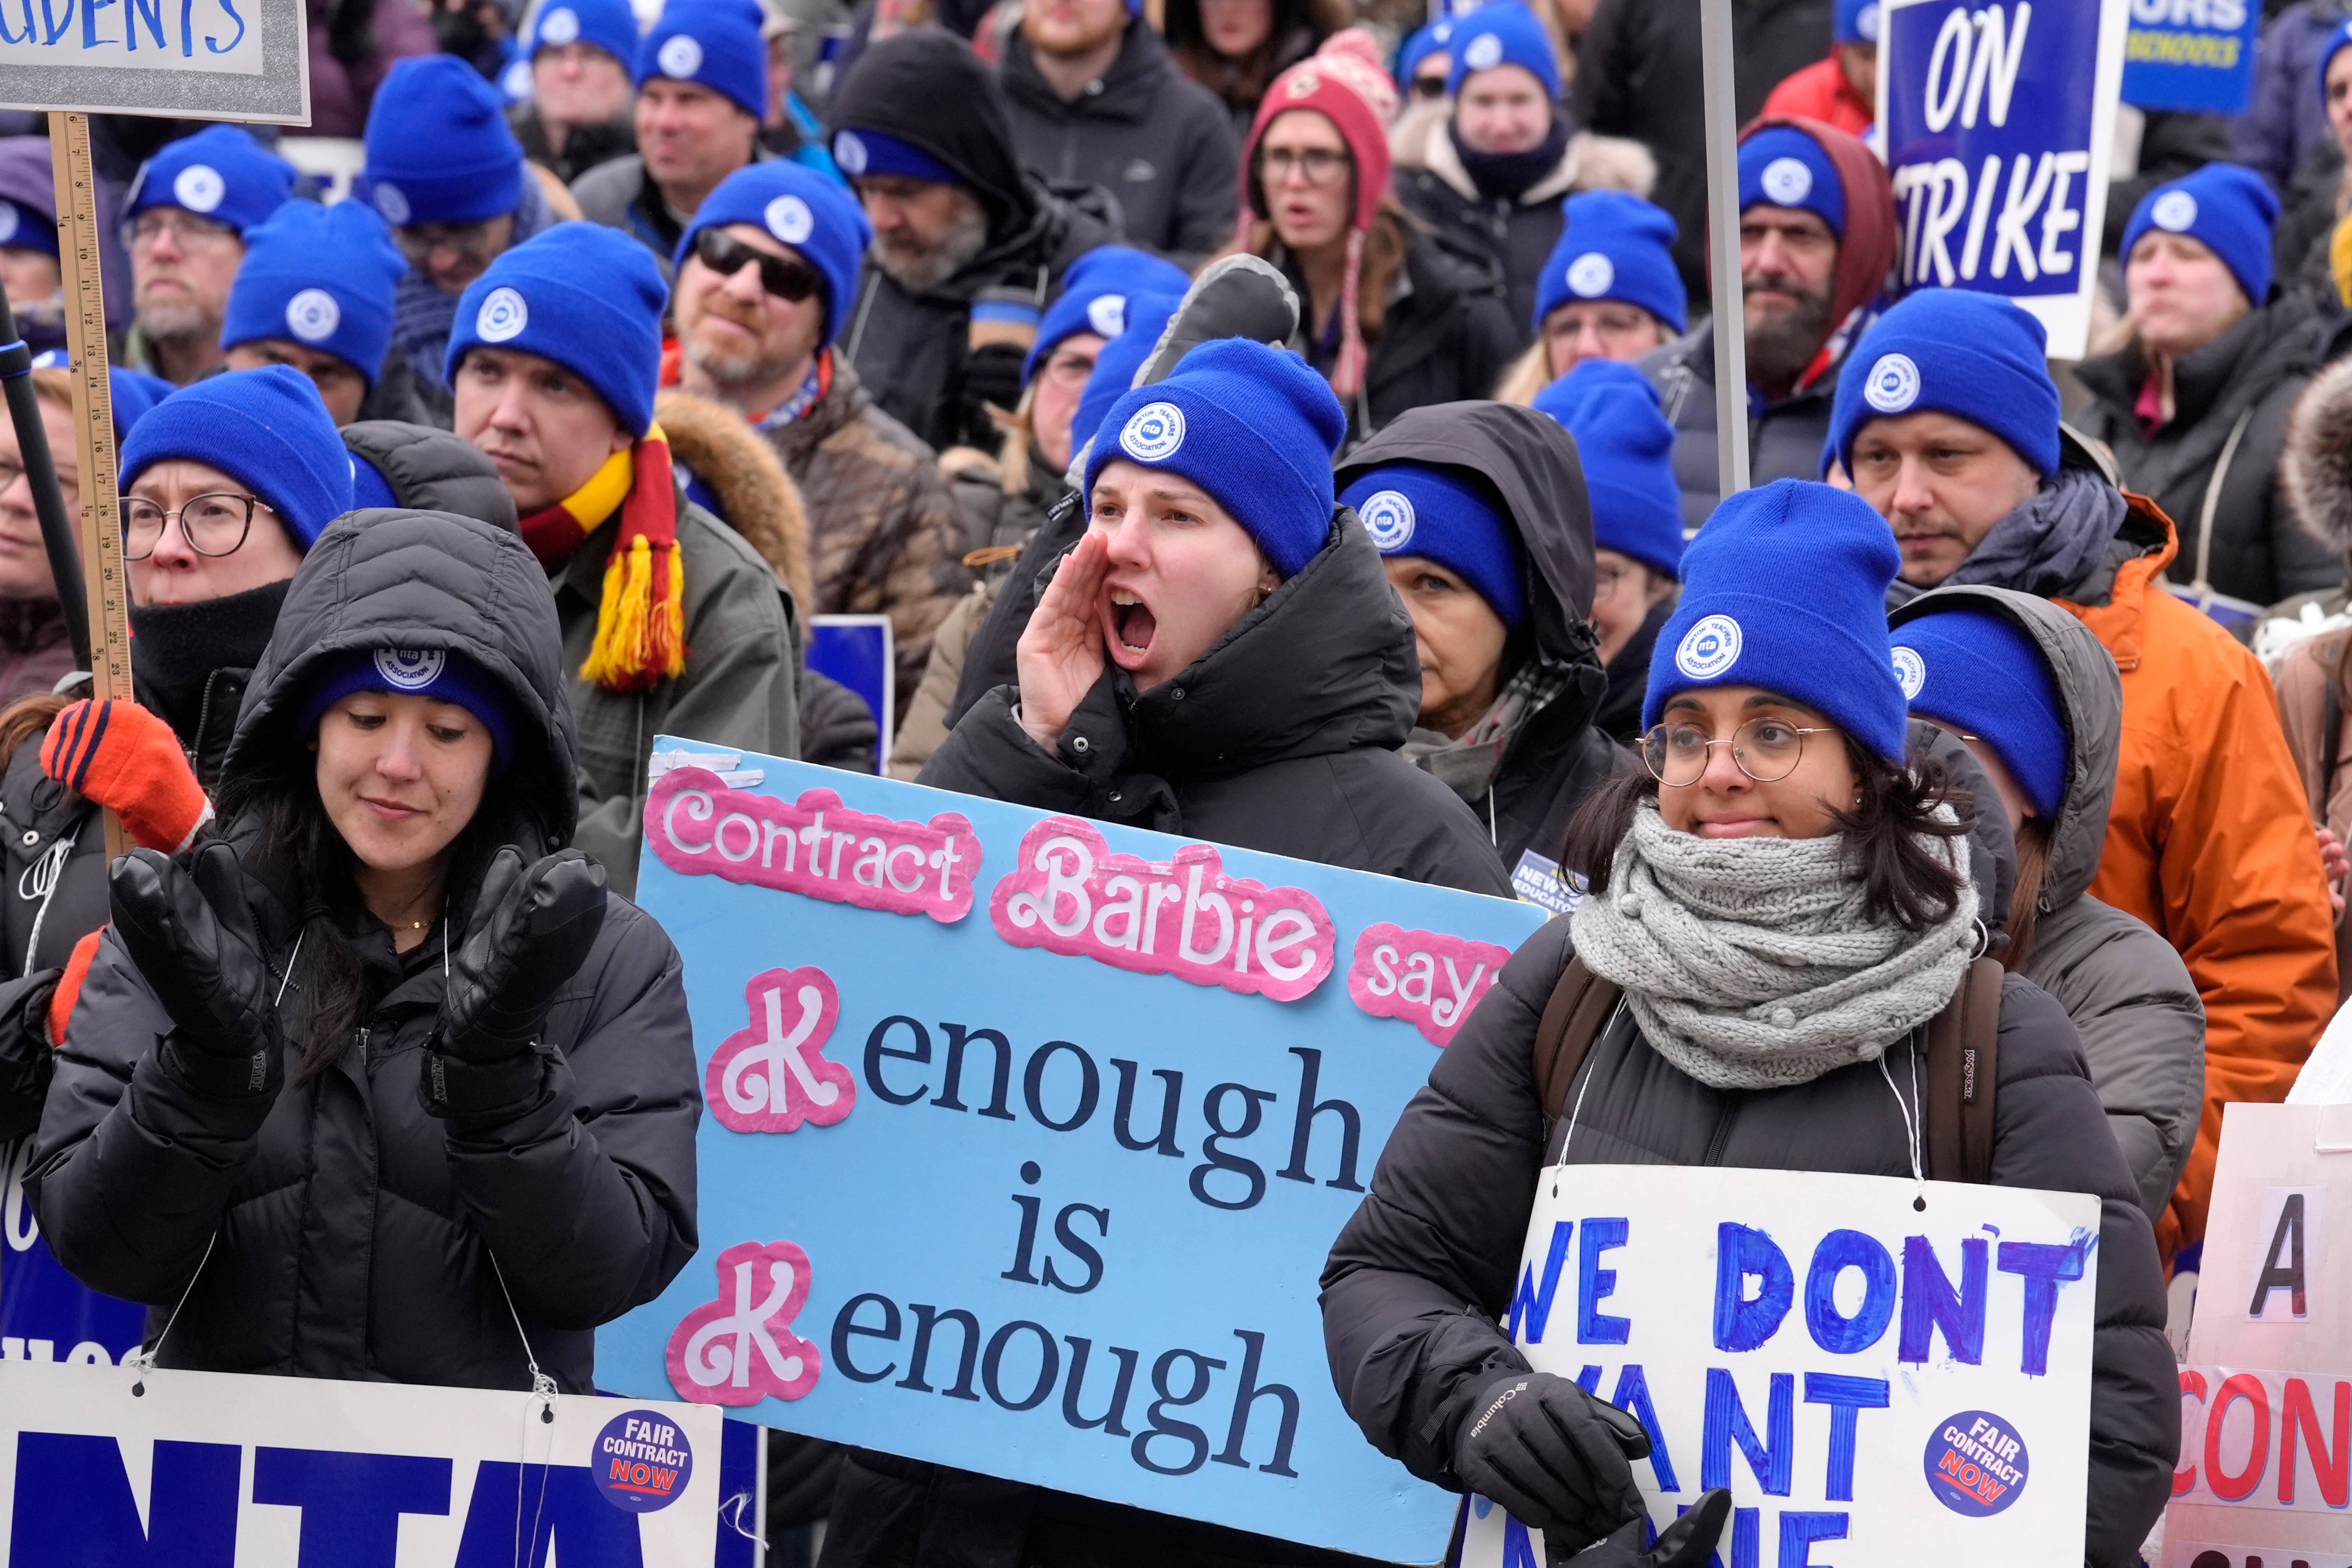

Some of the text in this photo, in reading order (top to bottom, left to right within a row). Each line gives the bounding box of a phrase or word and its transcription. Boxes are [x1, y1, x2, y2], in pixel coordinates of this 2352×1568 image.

[1924, 1, 2033, 133] ON
[1129, 434, 1167, 451] ASSOCIATION
[1130, 409, 1175, 437] NEWTON TEACHERS
[1142, 424, 1161, 435] nta
[1685, 623, 1732, 652] NEWTON TEACHERS
[1698, 640, 1717, 652] nta
[386, 660, 430, 679] ASSOCIATION
[1686, 653, 1726, 669] ASSOCIATION
[663, 788, 1501, 1027] Contract Barbie say
[1001, 1160, 1110, 1294] is
[2249, 1194, 2307, 1317] A
[1508, 1217, 1631, 1345] WE
[624, 1418, 675, 1447] FAIR
[1470, 1389, 1516, 1437] Columbia
[1575, 1364, 1891, 1501] ANT
[603, 1436, 688, 1467] CONTRACT
[1943, 1425, 2024, 1486] CONTRACT
[1969, 1417, 2021, 1463] FAIR
[609, 1458, 678, 1490] NOW
[1938, 1448, 2007, 1502] NOW
